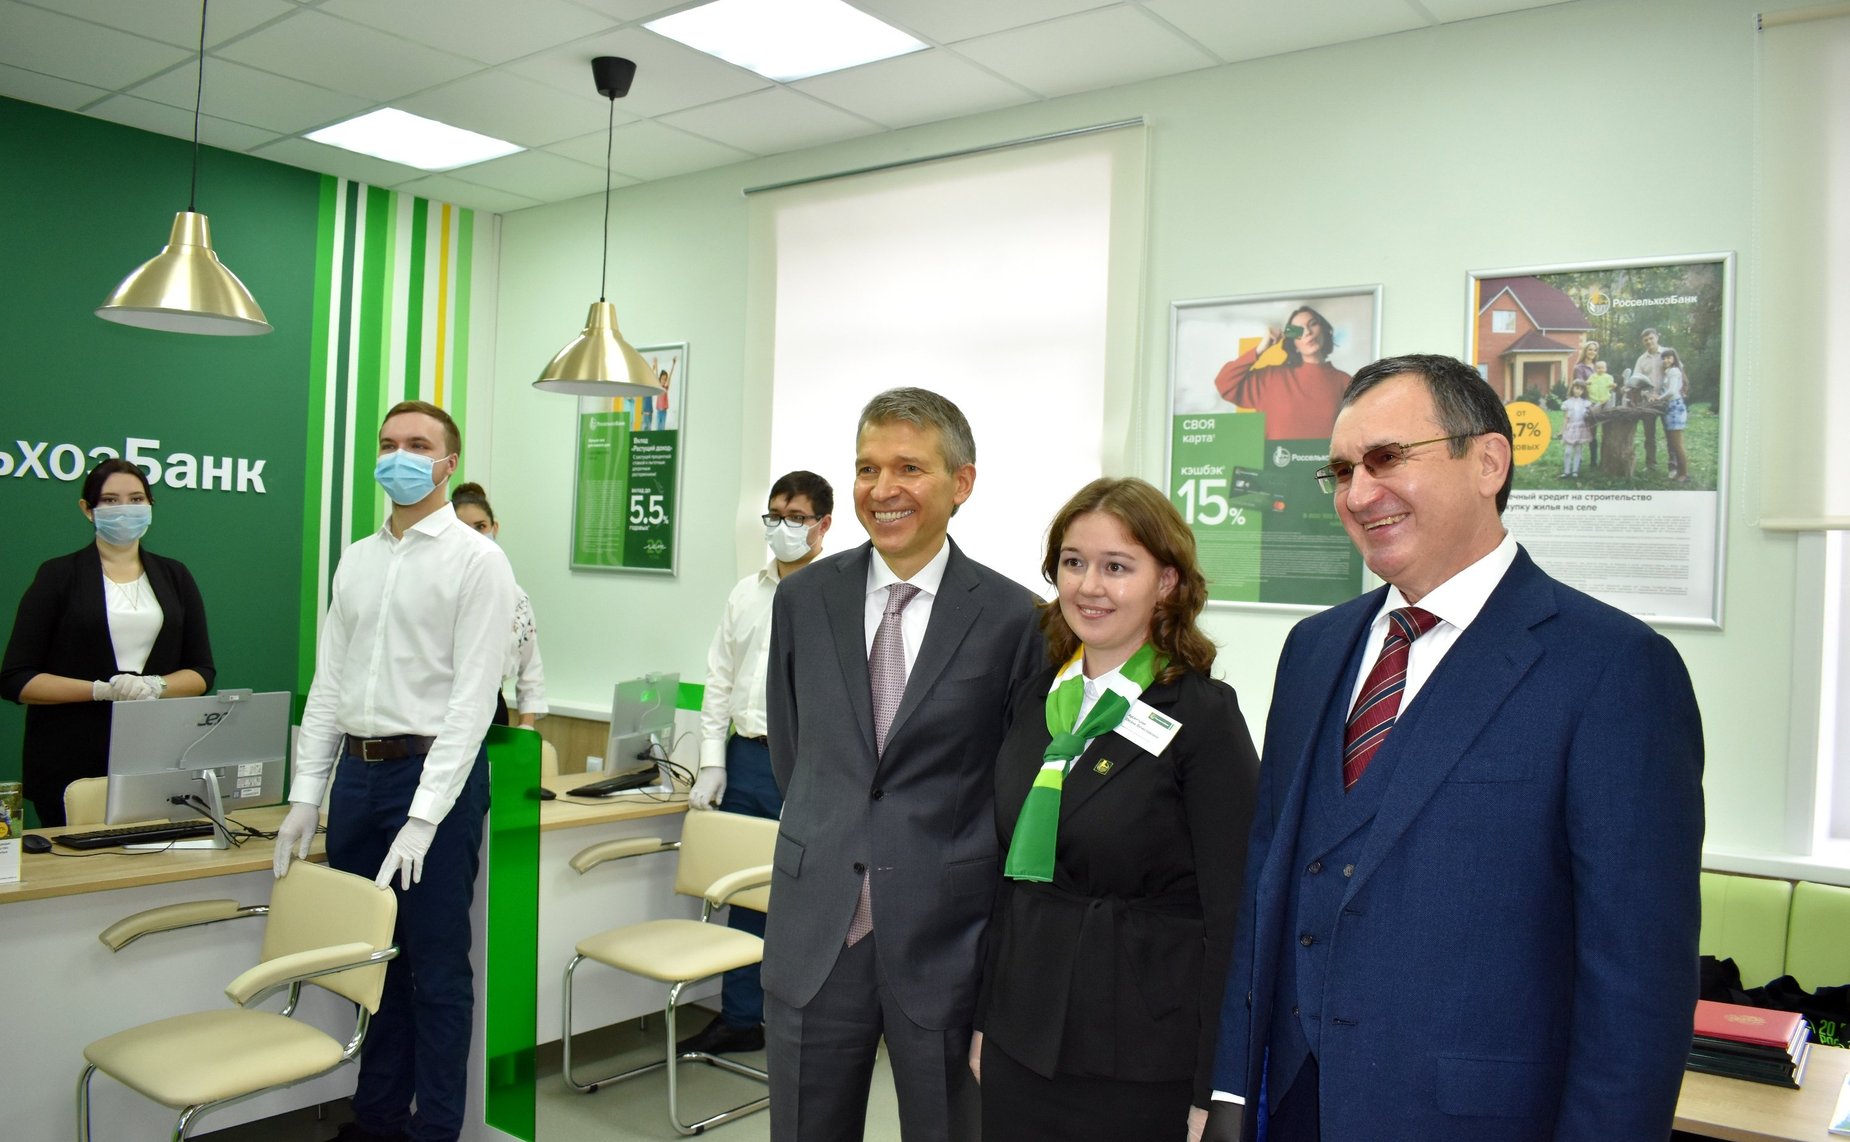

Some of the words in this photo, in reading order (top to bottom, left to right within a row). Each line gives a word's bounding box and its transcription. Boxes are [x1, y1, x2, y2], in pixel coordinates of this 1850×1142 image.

[1612, 295, 1698, 308] РоссельхозБанк
[1182, 419, 1216, 430] СВОЯ
[1177, 478, 1246, 526] 15%
[1538, 493, 1570, 502] кредит
[1584, 494, 1653, 503] строительство
